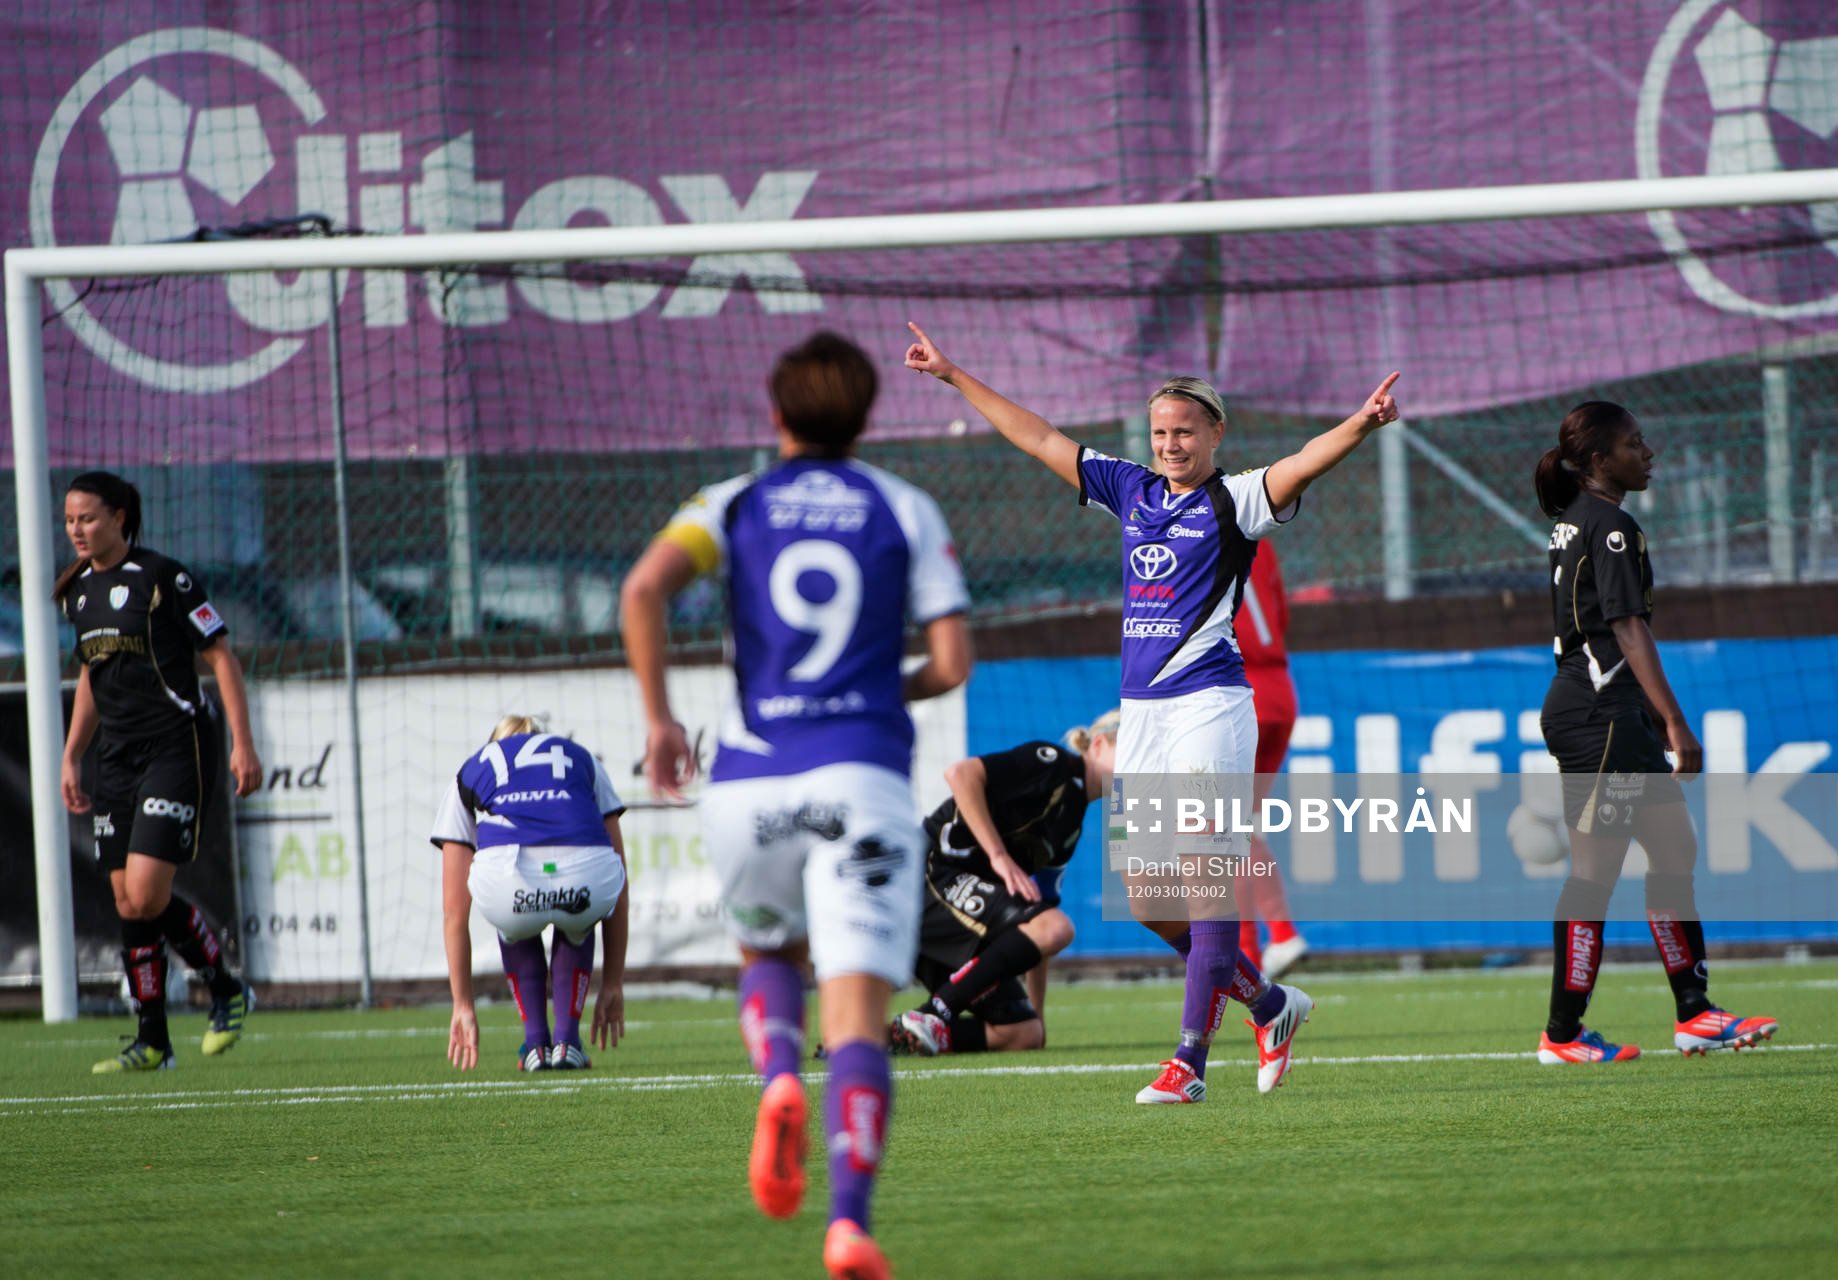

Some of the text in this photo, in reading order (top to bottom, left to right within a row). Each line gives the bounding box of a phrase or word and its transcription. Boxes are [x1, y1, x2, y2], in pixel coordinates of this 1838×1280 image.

[768, 539, 864, 682] 9
[1129, 585, 1175, 599] TOYOTA
[479, 733, 573, 787] 14
[143, 797, 195, 823] coop
[494, 789, 571, 805] VOLVIA
[1624, 804, 1633, 825] 2
[272, 832, 351, 884] AB
[1571, 924, 1595, 987] Stavdal
